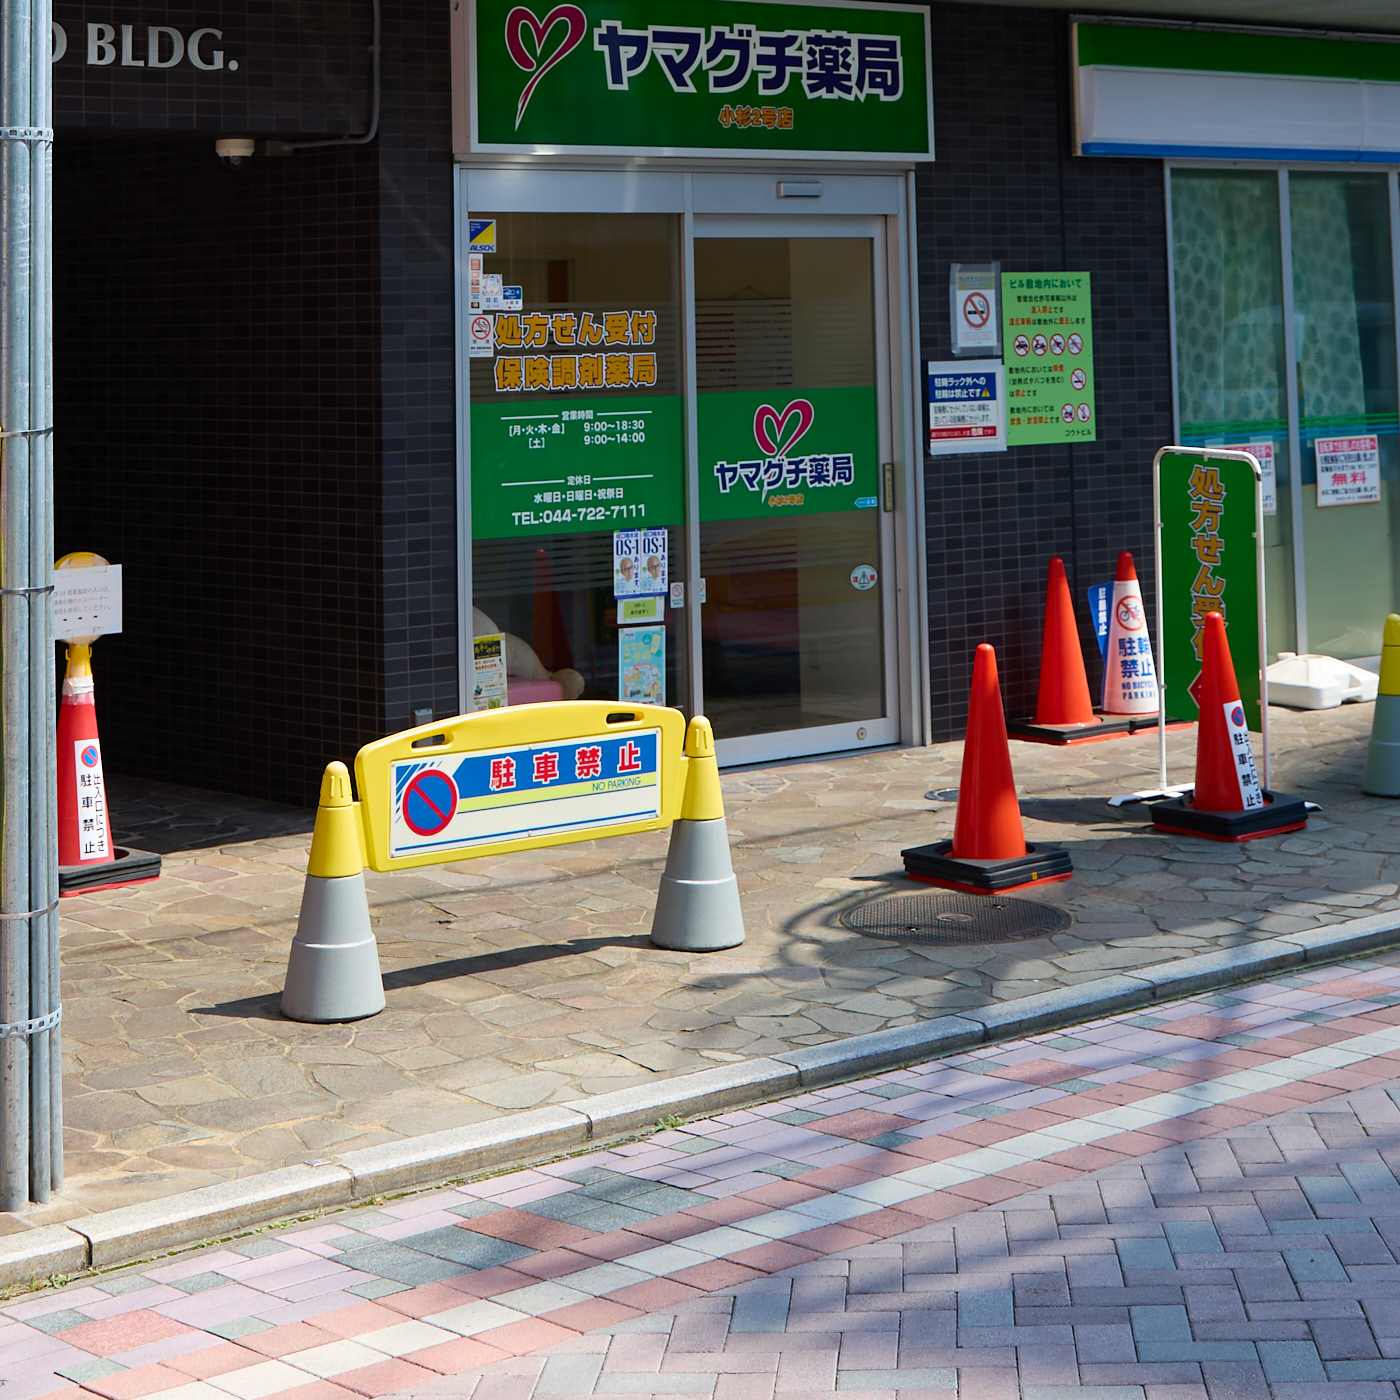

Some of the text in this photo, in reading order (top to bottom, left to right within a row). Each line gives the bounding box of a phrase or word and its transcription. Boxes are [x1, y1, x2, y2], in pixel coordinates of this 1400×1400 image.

[86, 21, 240, 72] BLDG.
[593, 19, 904, 102] ヤマグチ薬局
[718, 105, 795, 131] 小杉2号店
[1009, 278, 1082, 290] ビル敷地内において
[494, 310, 657, 349] 処方せん受付
[494, 352, 658, 392] 保険調剤薬局
[561, 409, 594, 421] 営業時間
[566, 474, 592, 486] 定休日
[713, 453, 855, 493] ヤマグチ薬局
[1331, 470, 1367, 487] 無料
[511, 503, 646, 526] TEL:044-722-7111
[615, 538, 639, 556] OS-1
[642, 537, 666, 555] OS-1
[1187, 465, 1227, 662] 処方せん受
[1118, 636, 1151, 657] 駐輪
[1120, 658, 1153, 679] 禁止
[489, 741, 642, 791] 駐車禁止
[1233, 731, 1256, 808] 駐車禁止
[591, 775, 642, 793] NO PARKING
[80, 772, 97, 856] 駐車禁止
[92, 772, 106, 854] 出入口につき
